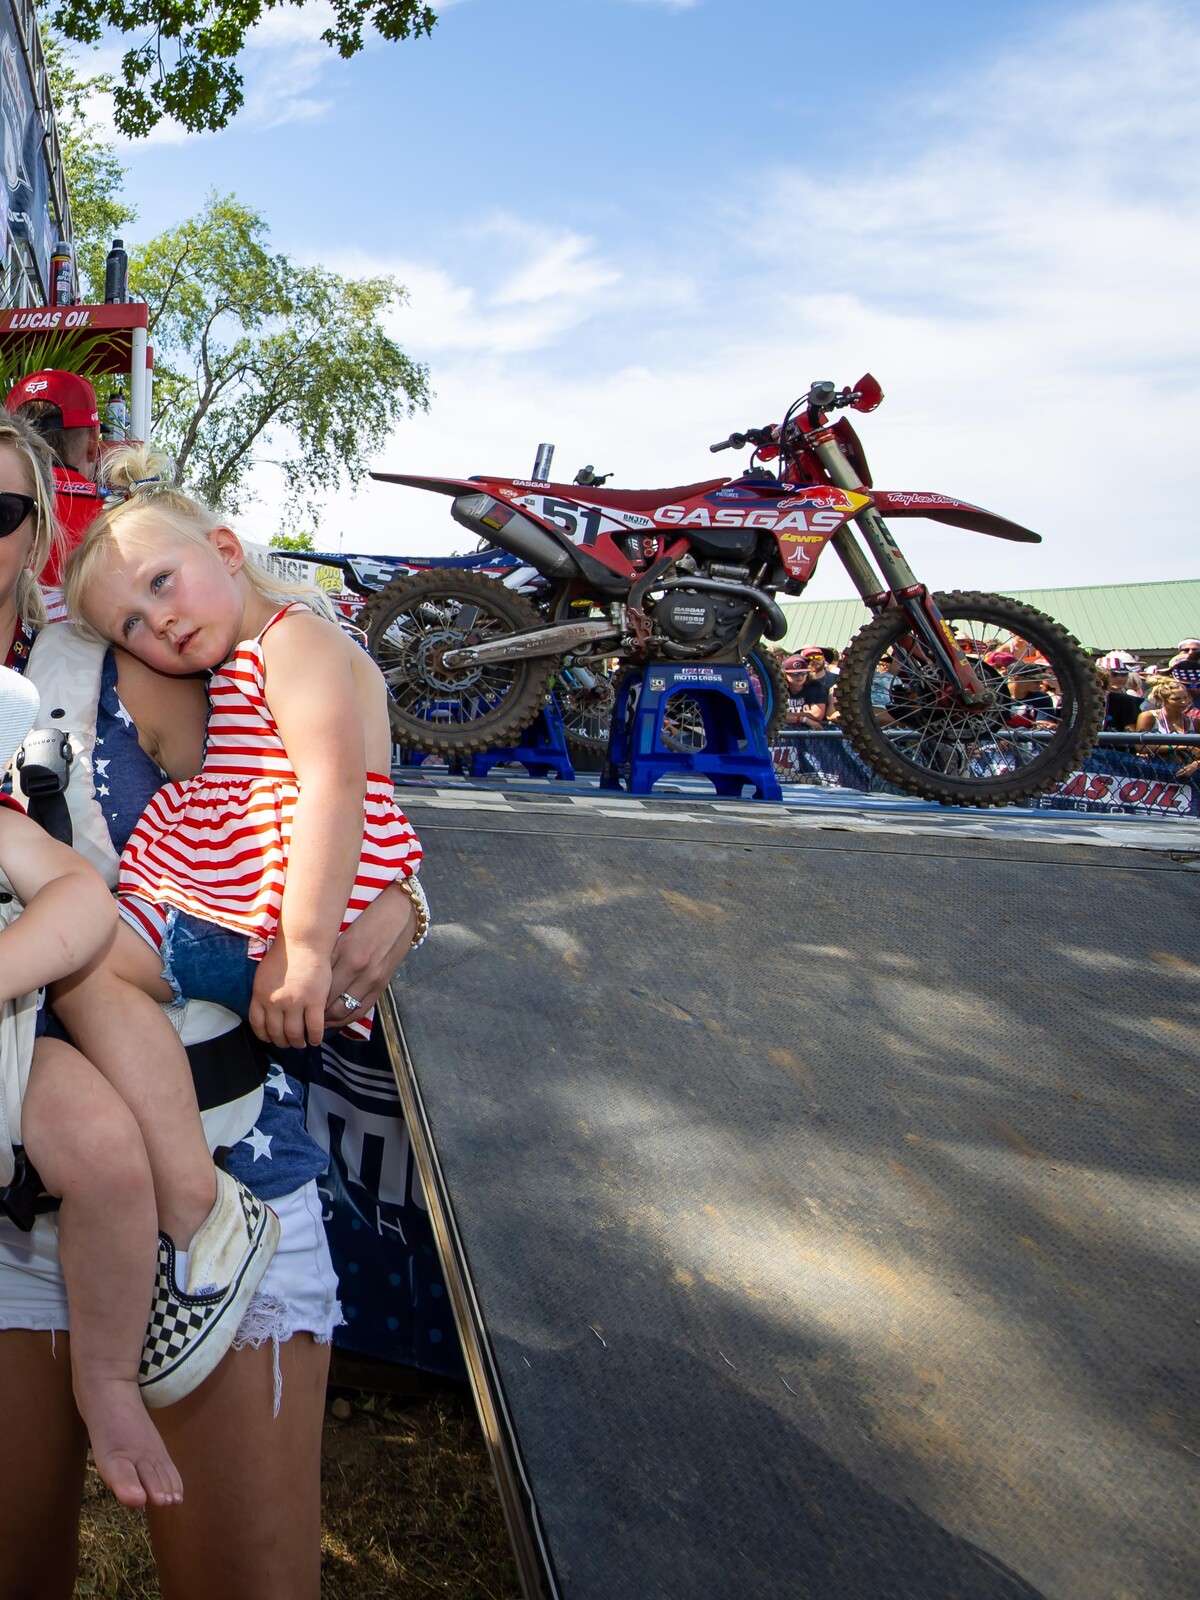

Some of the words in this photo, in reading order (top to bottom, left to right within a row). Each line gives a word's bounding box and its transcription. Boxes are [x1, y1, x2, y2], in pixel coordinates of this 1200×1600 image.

[9, 312, 62, 330] LUCAS
[65, 310, 91, 328] OIL
[512, 479, 550, 489] GASGAS
[887, 493, 911, 506] Troy
[912, 493, 932, 504] Lee
[543, 497, 602, 547] 51
[653, 505, 845, 532] GASGAS
[317, 565, 340, 581] MOTO
[321, 578, 342, 591] TEES
[1119, 780, 1183, 808] OIL
